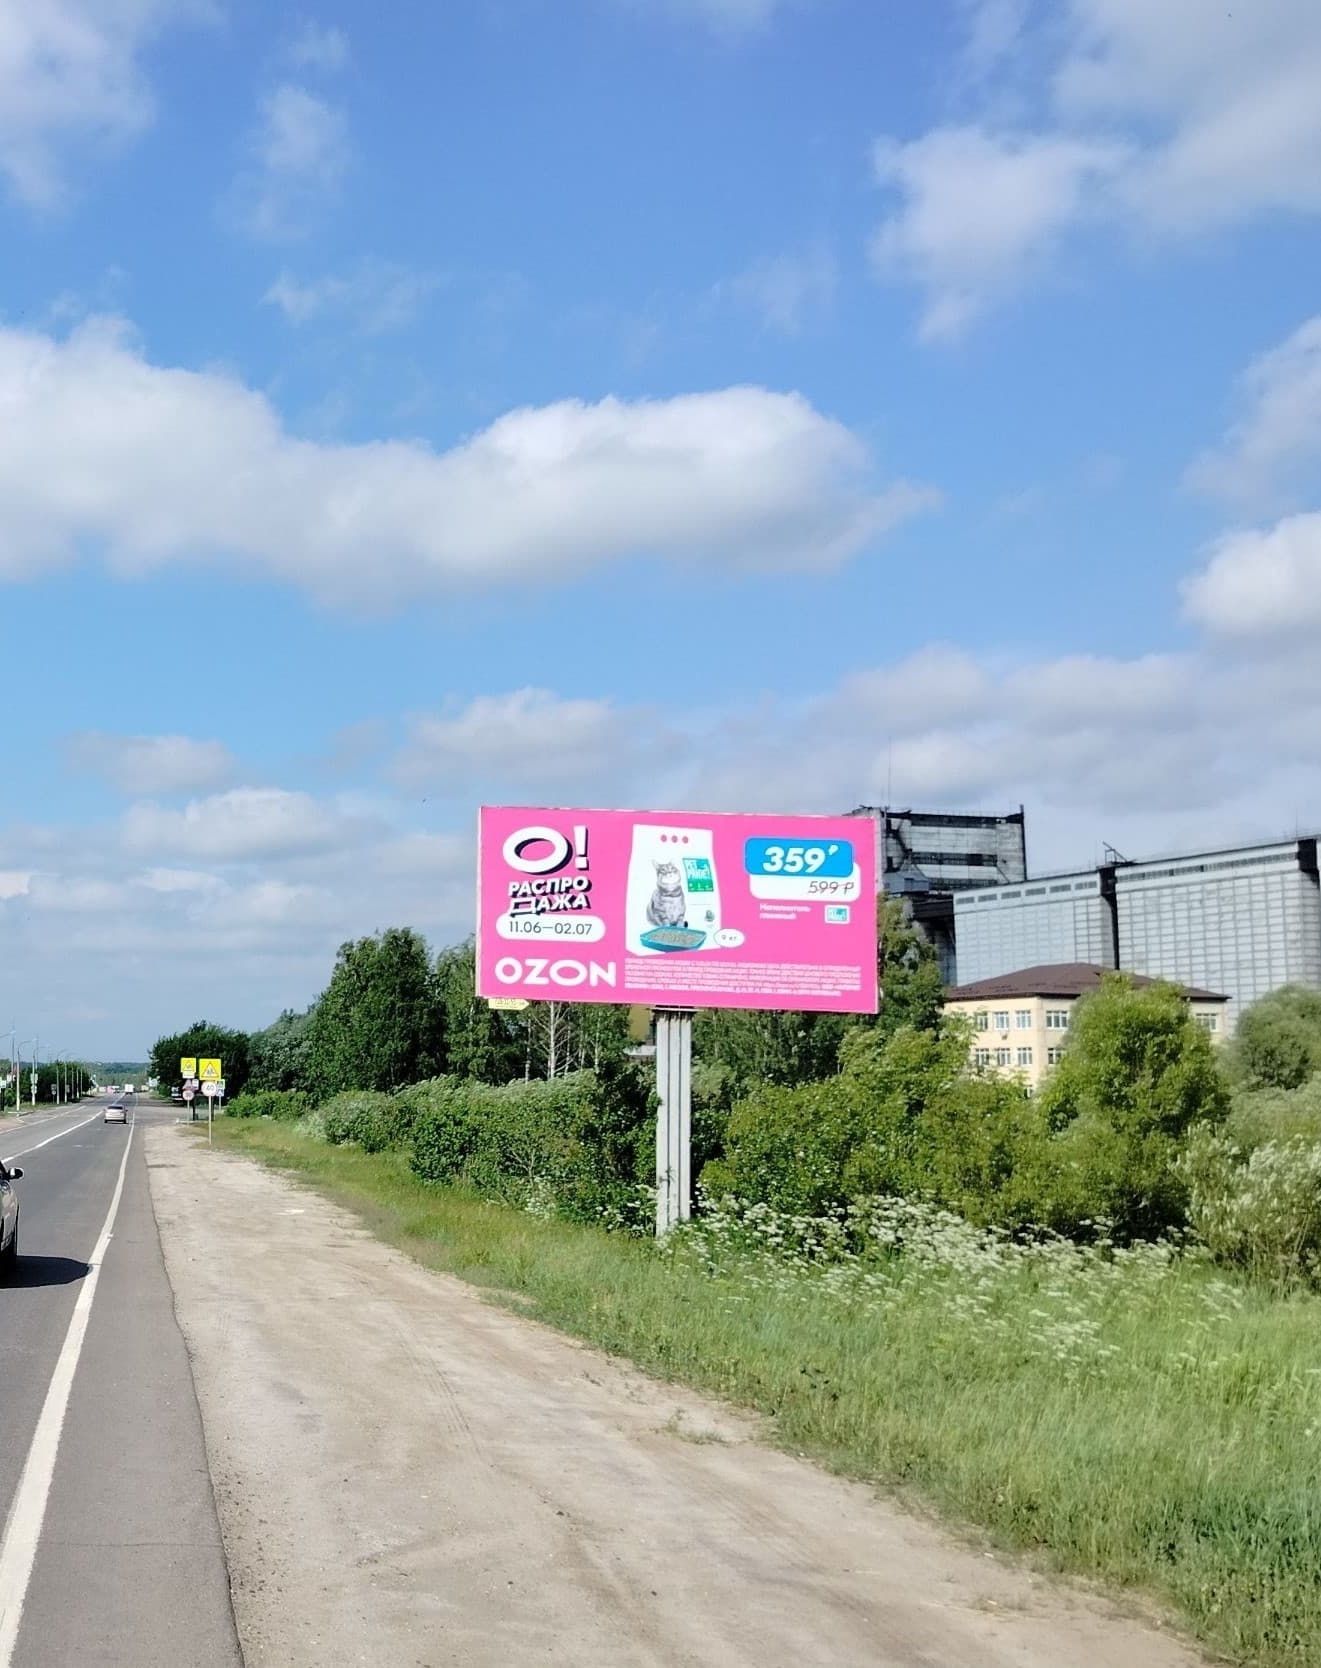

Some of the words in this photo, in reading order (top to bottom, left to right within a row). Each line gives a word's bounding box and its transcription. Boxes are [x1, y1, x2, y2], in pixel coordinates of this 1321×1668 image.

[502, 825, 589, 875] О!
[508, 876, 591, 897] РАСПРО
[808, 880, 839, 894] 599
[508, 893, 590, 916] ДАЖА
[495, 957, 616, 988] OZON
